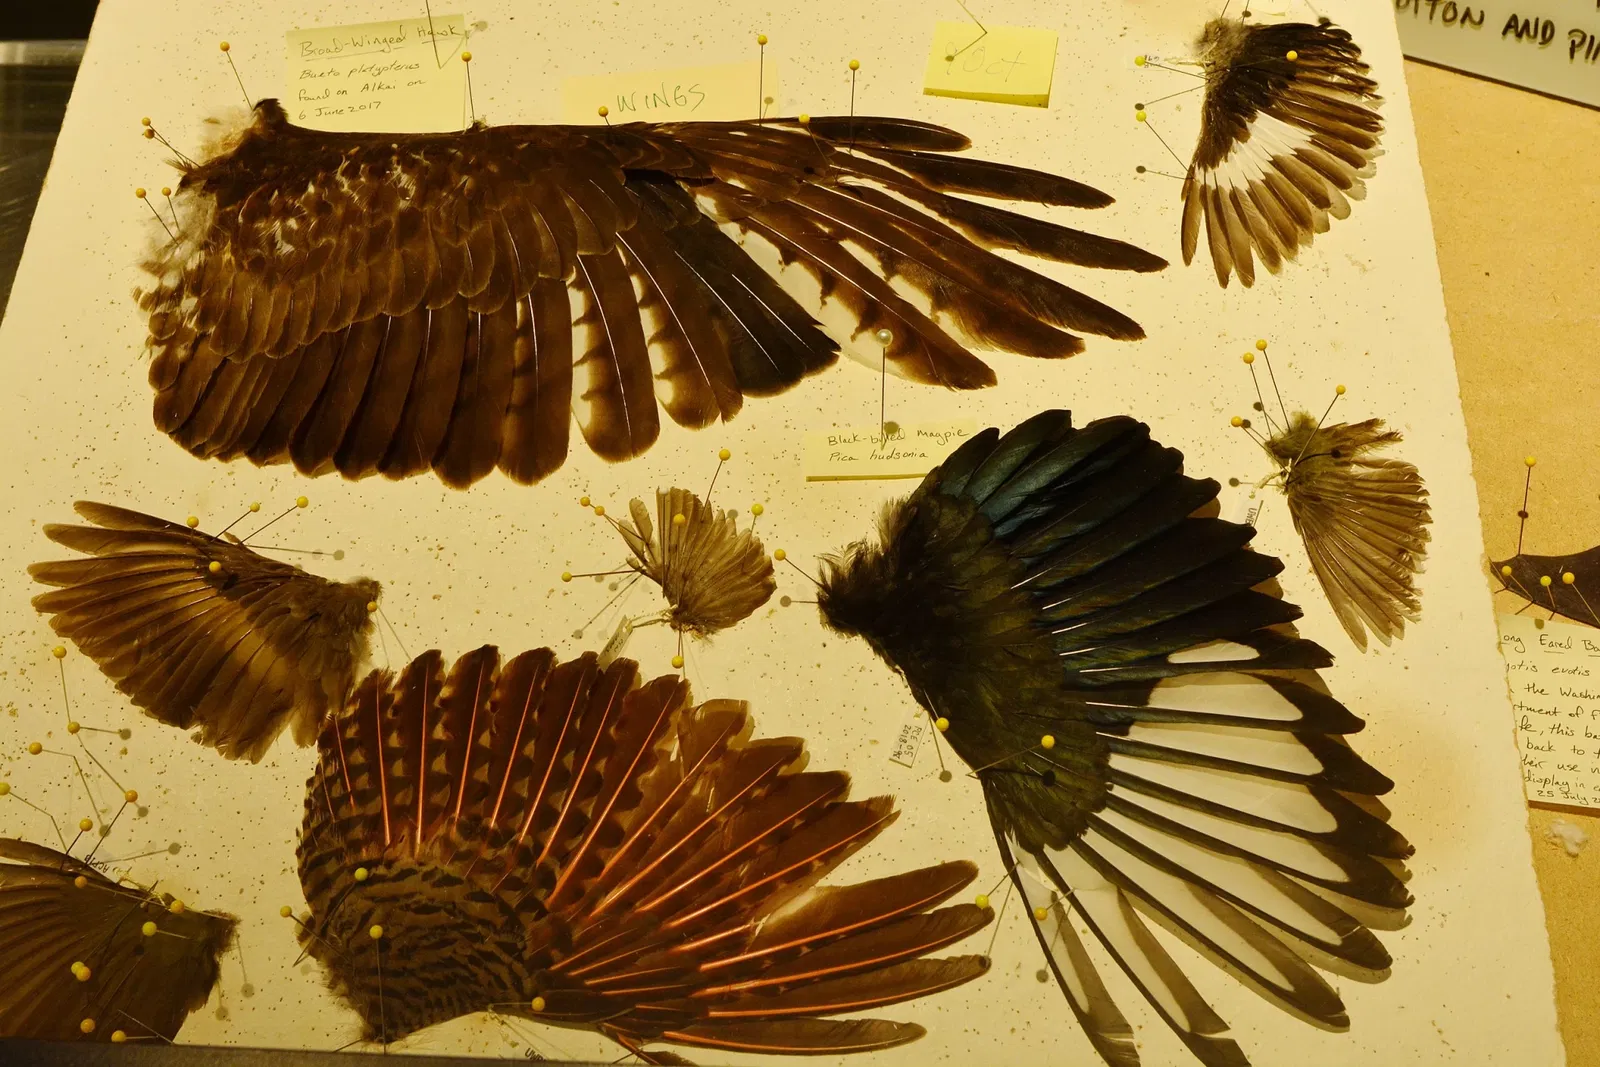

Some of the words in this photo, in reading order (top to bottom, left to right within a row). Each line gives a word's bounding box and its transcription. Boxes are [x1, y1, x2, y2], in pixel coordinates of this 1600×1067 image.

[1502, 13, 1556, 46] AND
[300, 25, 407, 57] Broad-Winged
[417, 24, 461, 39] Hawk
[299, 88, 331, 101] found
[407, 79, 427, 87] on
[616, 82, 706, 113] WINGS
[298, 109, 307, 121] 6
[314, 106, 345, 117] June
[347, 101, 382, 113] 2017
[916, 426, 971, 446] Magpie
[829, 452, 859, 463] Pica
[869, 449, 929, 461] hudsonia
[1502, 634, 1526, 654] ong
[1539, 633, 1573, 650] Eared
[1524, 682, 1550, 696] the
[1568, 705, 1584, 718] of
[1548, 722, 1575, 737] this
[1526, 736, 1557, 752] back
[1570, 745, 1586, 756] to
[1557, 763, 1582, 773] use
[1523, 768, 1571, 793] display
[1536, 789, 1555, 798] 25
[1560, 792, 1590, 806] July
